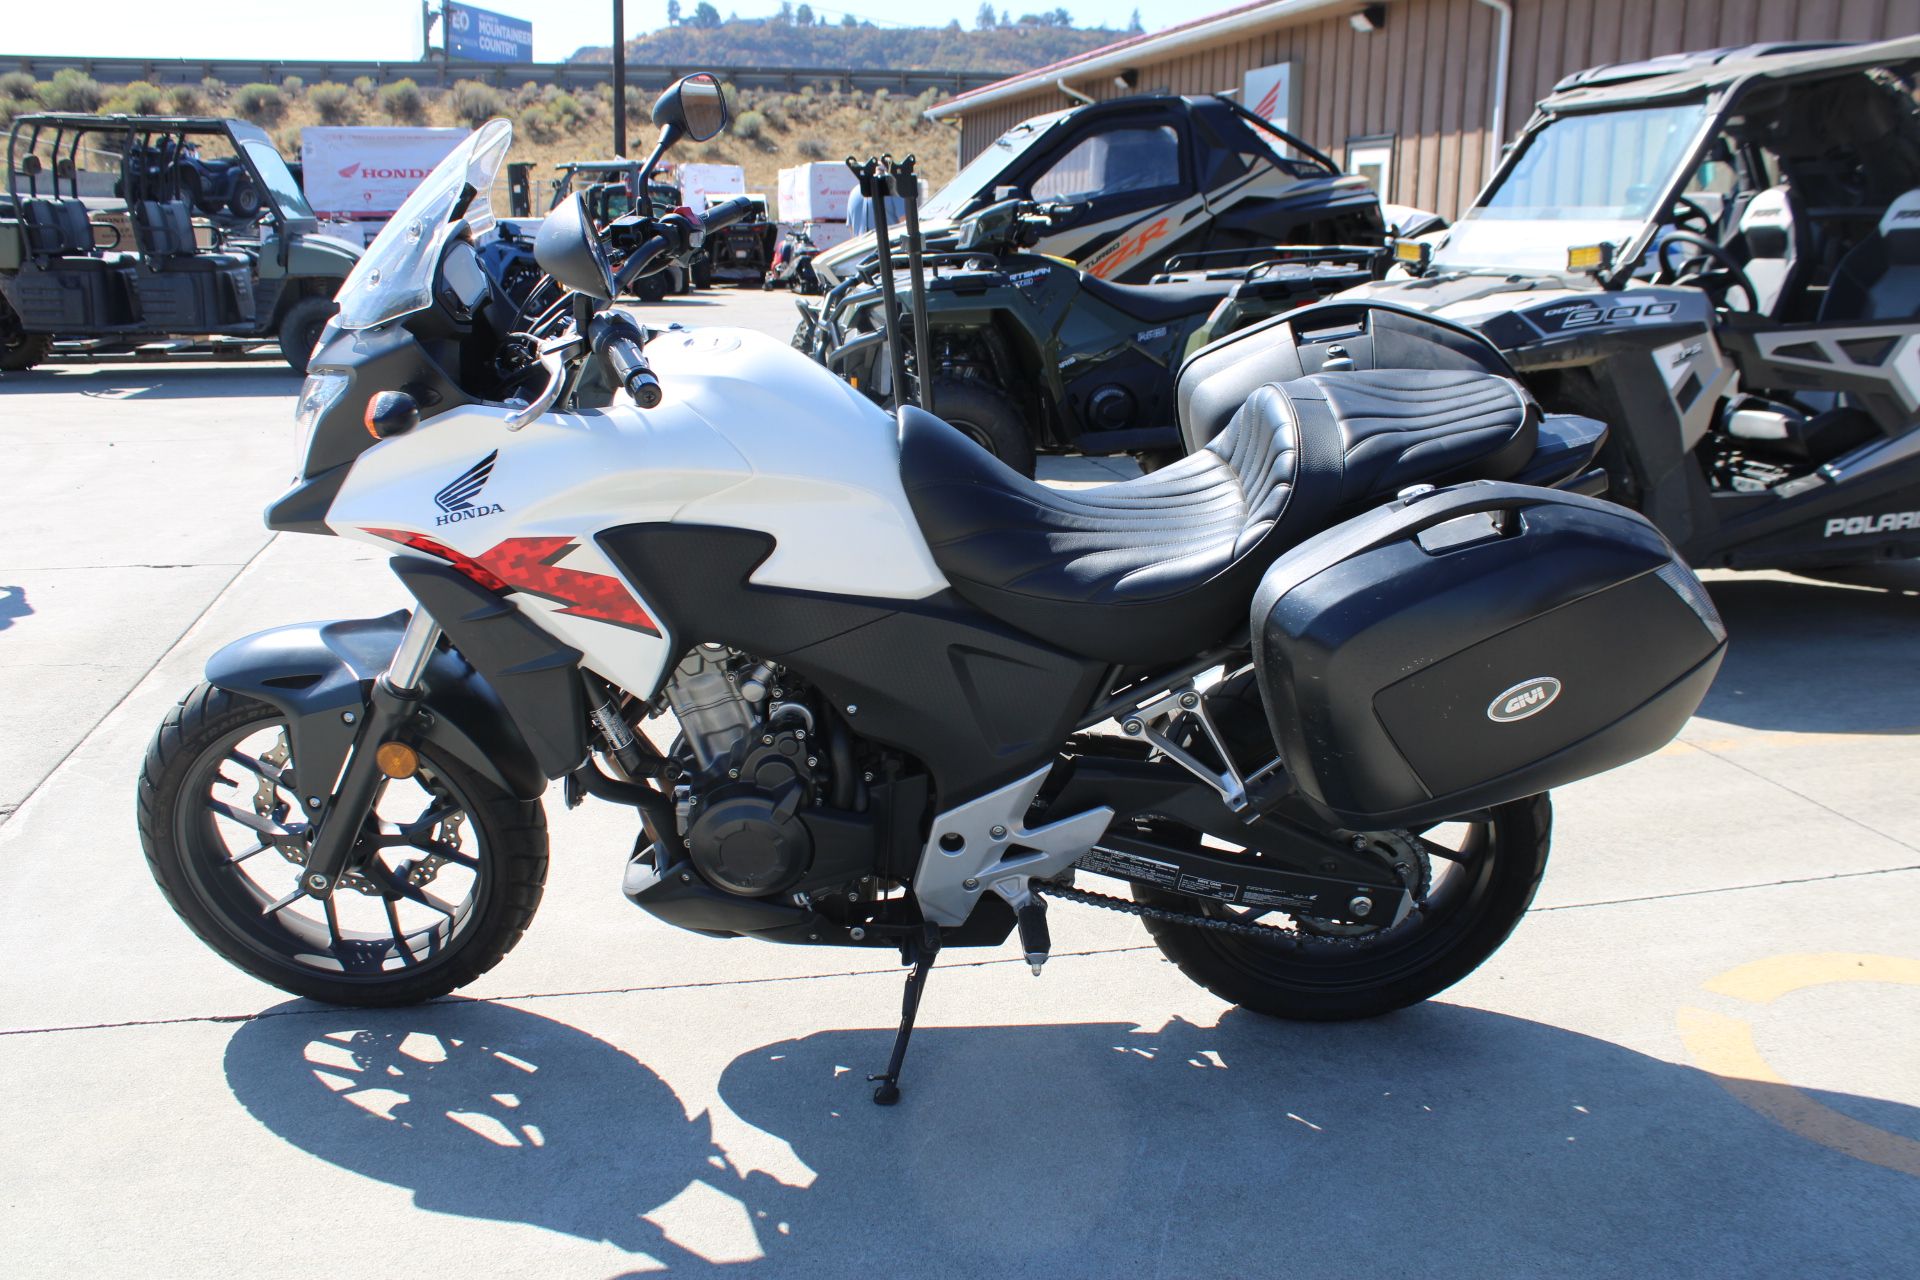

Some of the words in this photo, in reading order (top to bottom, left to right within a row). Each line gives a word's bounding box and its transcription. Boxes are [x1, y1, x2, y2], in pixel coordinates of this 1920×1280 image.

[479, 21, 532, 45] MOUNTAINEER
[479, 36, 518, 57] COUNTRY!
[1084, 242, 1120, 269] TURBO
[1561, 300, 1681, 329] 900
[436, 503, 505, 526] HONDA
[1504, 686, 1546, 714] GIVI
